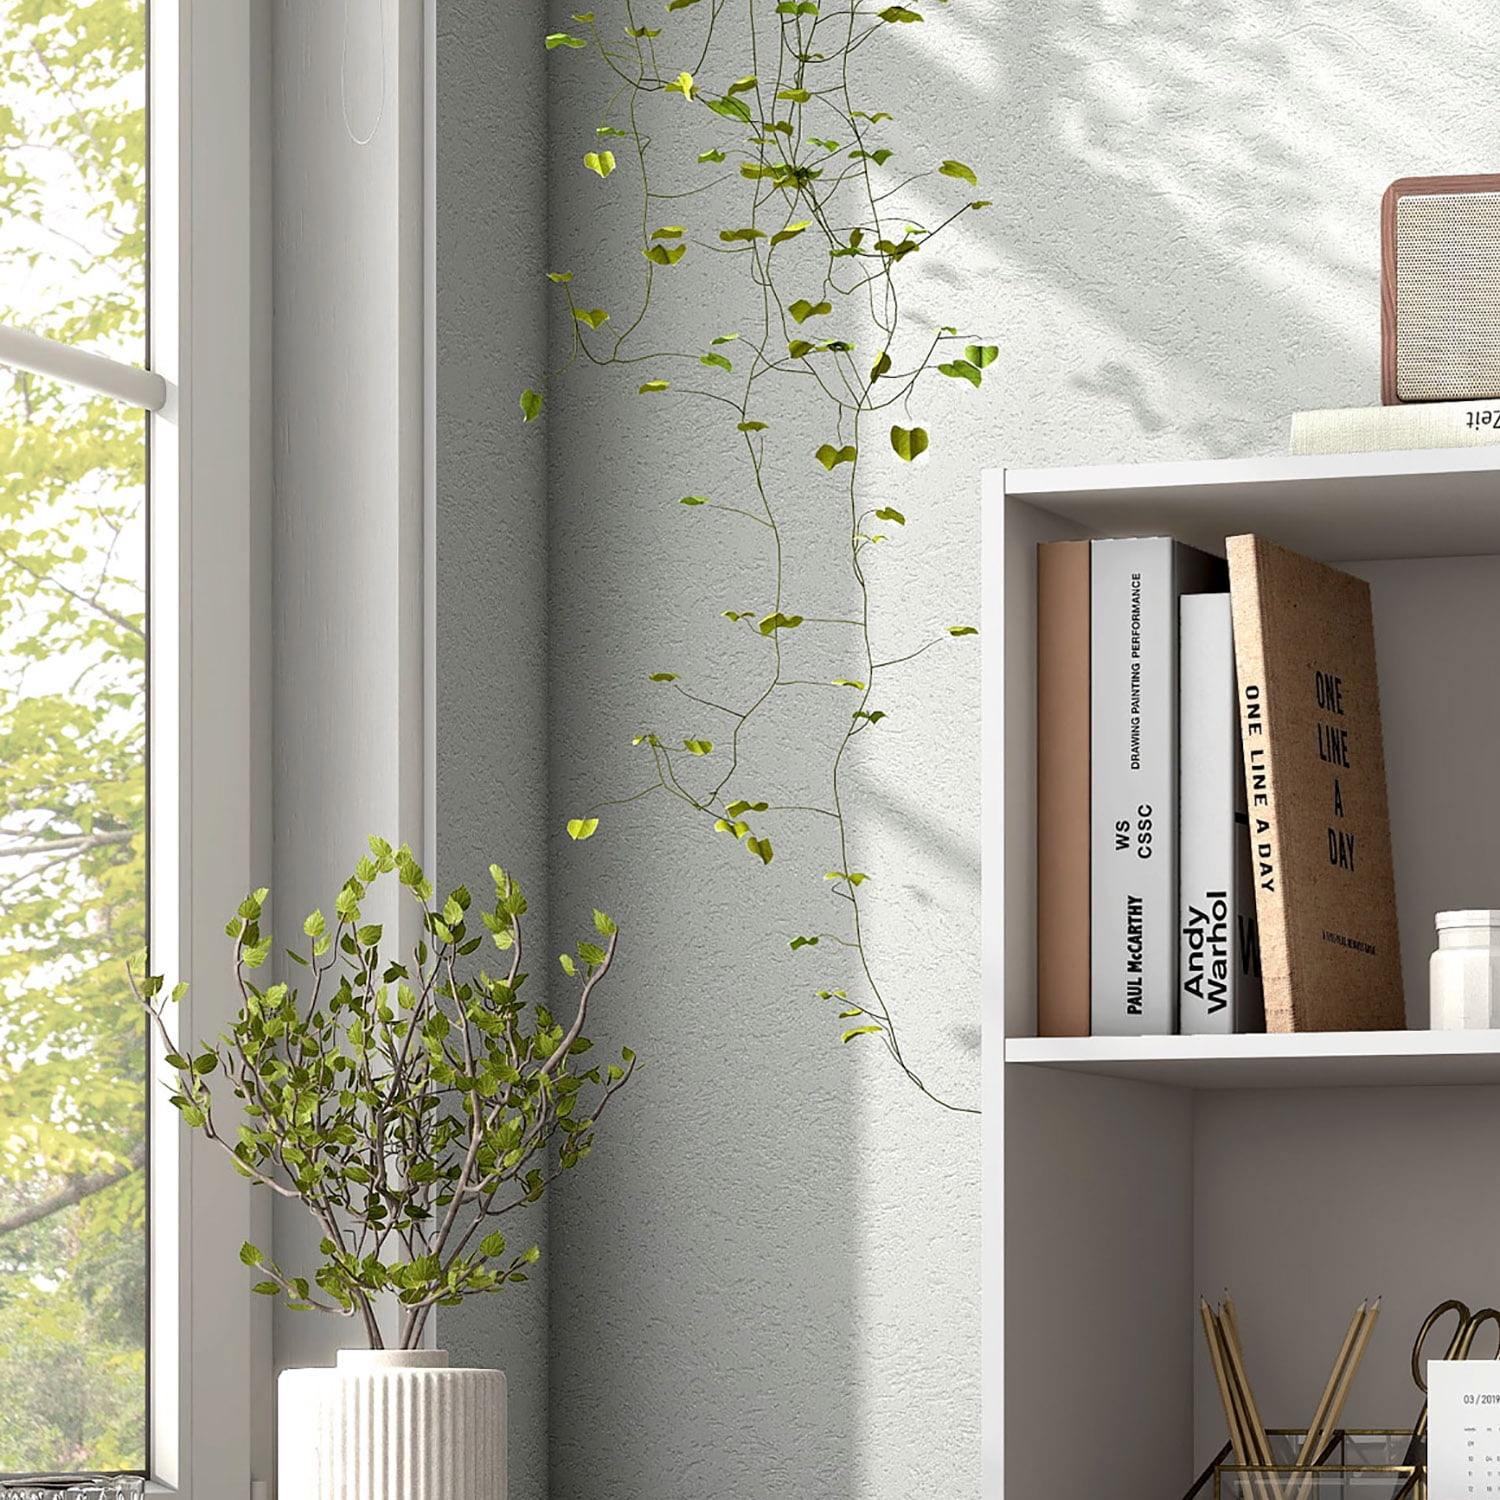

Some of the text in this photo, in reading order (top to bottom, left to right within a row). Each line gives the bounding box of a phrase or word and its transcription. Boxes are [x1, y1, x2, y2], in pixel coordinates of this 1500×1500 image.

[1131, 573, 1141, 770] DRAWING PAINTING PERFORMANCE
[1316, 671, 1344, 715] ONE
[1318, 723, 1350, 768] LINE
[1245, 685, 1275, 892] ONE LINE A DAY
[1334, 779, 1343, 817] A
[1116, 820, 1131, 850] WS
[1138, 804, 1152, 859] CSSC
[1328, 827, 1354, 872] DAY
[1127, 895, 1143, 1015] PAUL McCARTHY
[1183, 905, 1209, 999] Andy
[1206, 891, 1228, 1014] Warhol
